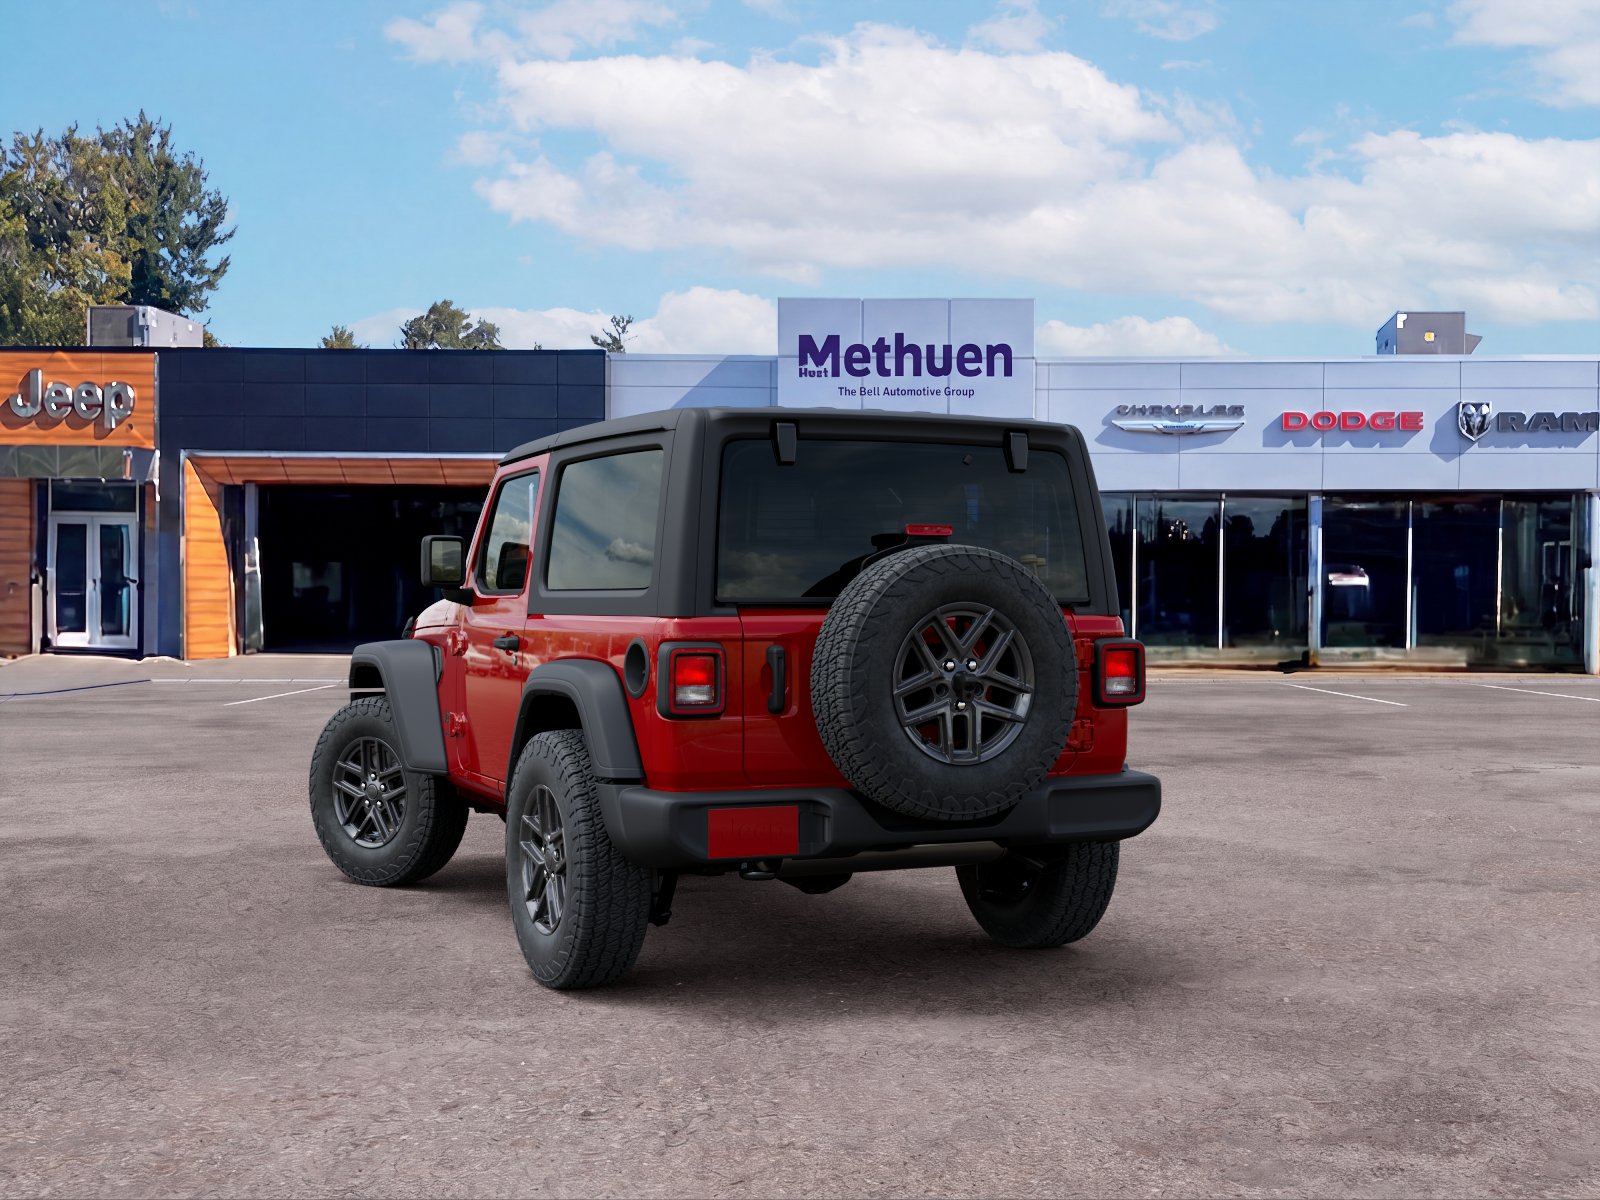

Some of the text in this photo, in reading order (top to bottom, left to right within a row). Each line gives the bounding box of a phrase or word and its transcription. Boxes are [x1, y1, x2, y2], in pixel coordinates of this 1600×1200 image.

[798, 332, 1013, 378] Methuen
[9, 368, 136, 430] Jeep
[838, 386, 975, 399] The Bell Automotive Group
[1282, 411, 1424, 430] DODGE
[1498, 411, 1600, 432] RAM
